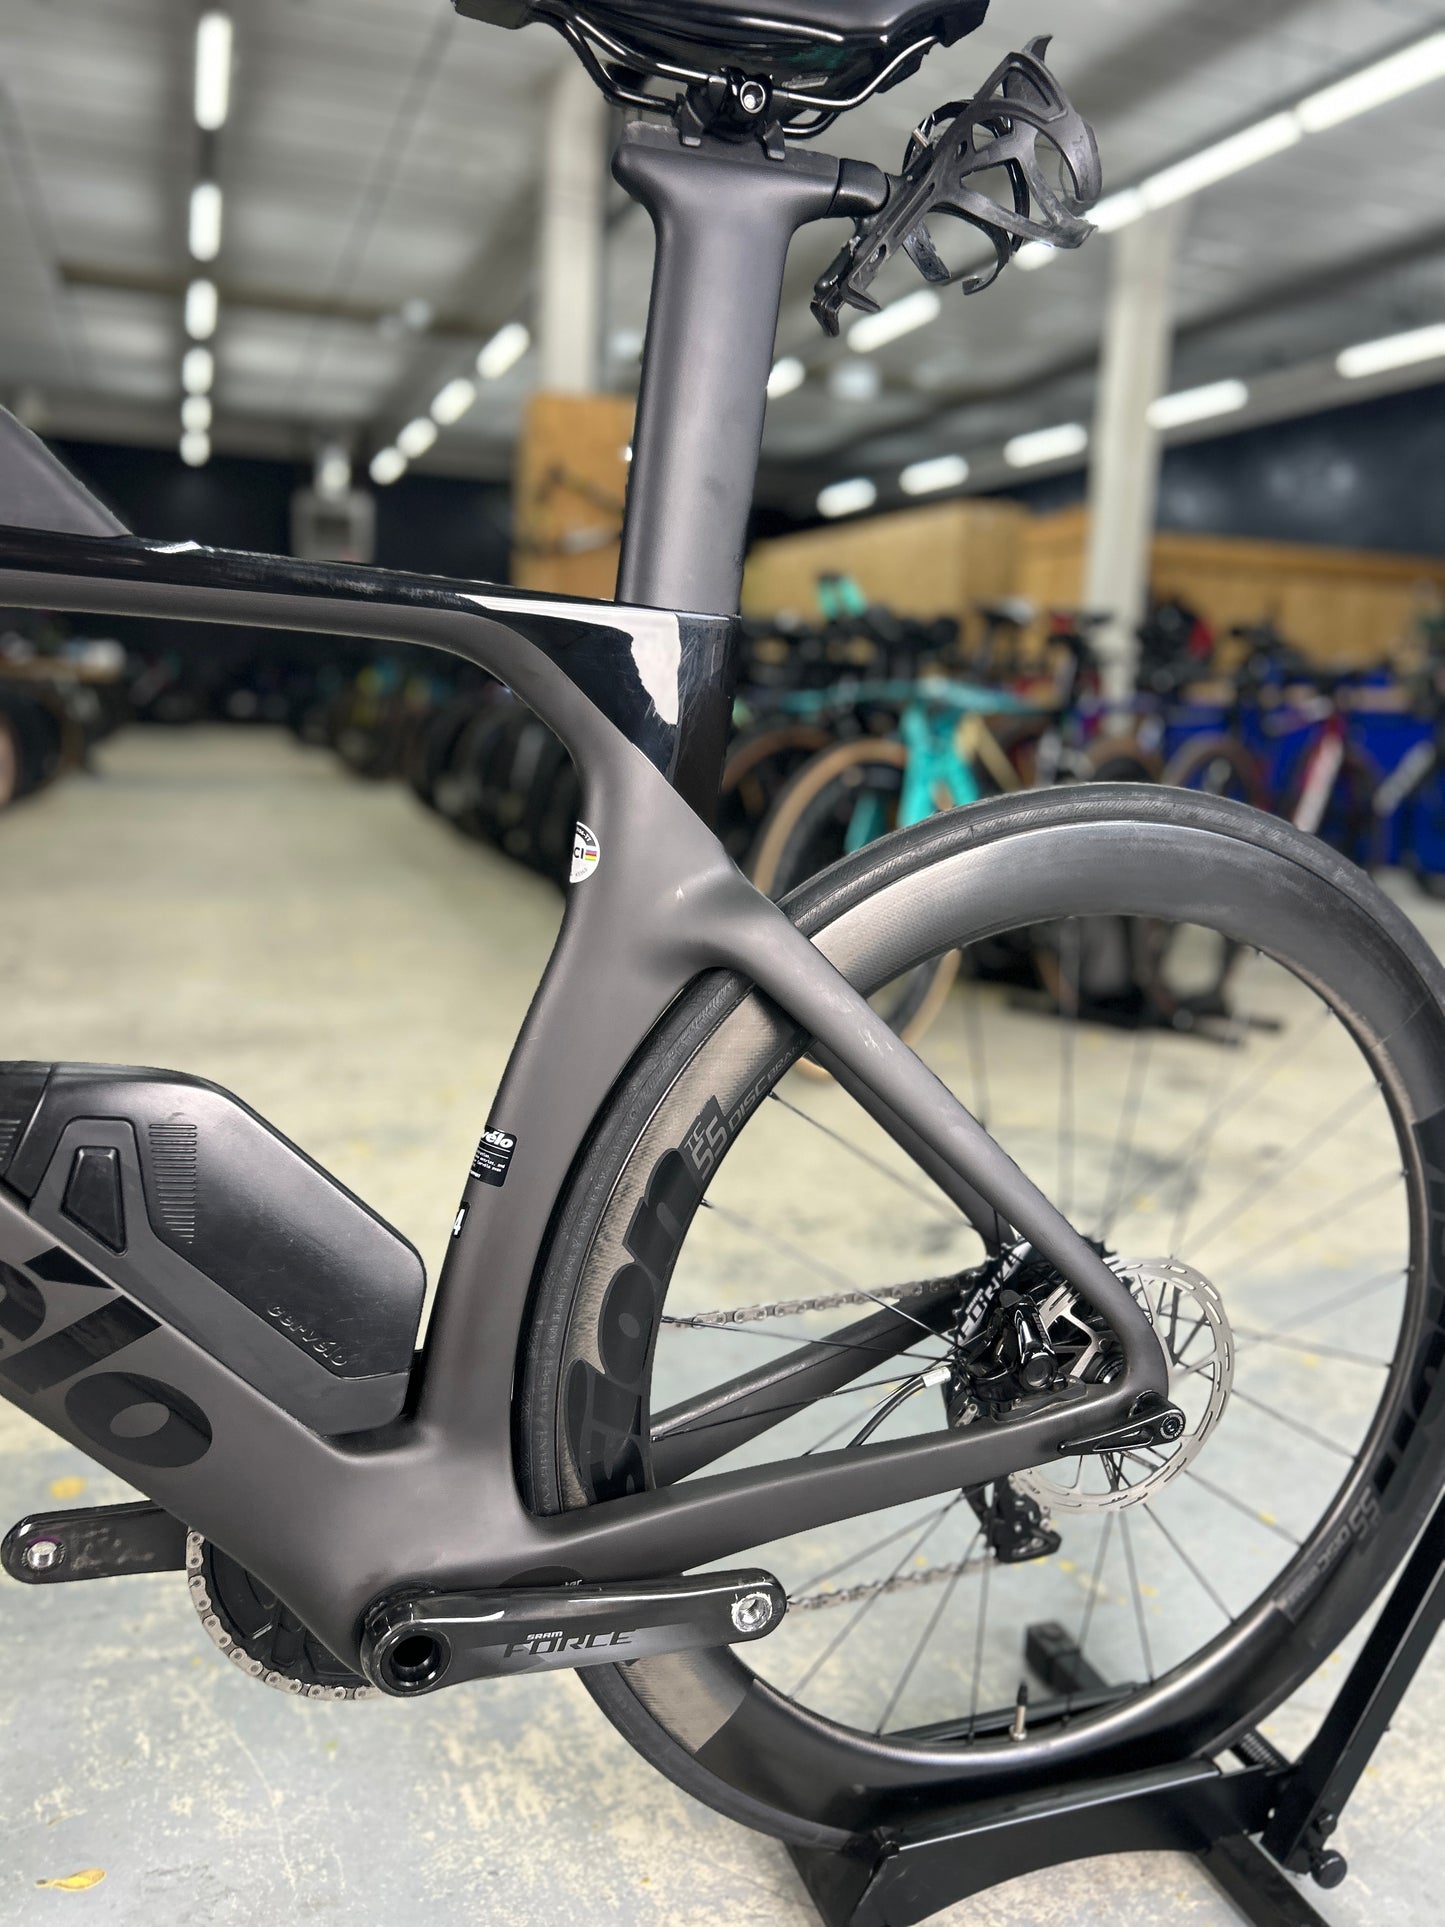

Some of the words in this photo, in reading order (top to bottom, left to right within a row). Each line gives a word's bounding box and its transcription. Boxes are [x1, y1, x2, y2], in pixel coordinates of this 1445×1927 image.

[684, 1121, 706, 1150] TC
[691, 1115, 728, 1181] 55
[728, 1076, 769, 1132] DISC
[503, 1628, 638, 1658] FORCE
[526, 1630, 563, 1641] SRAM
